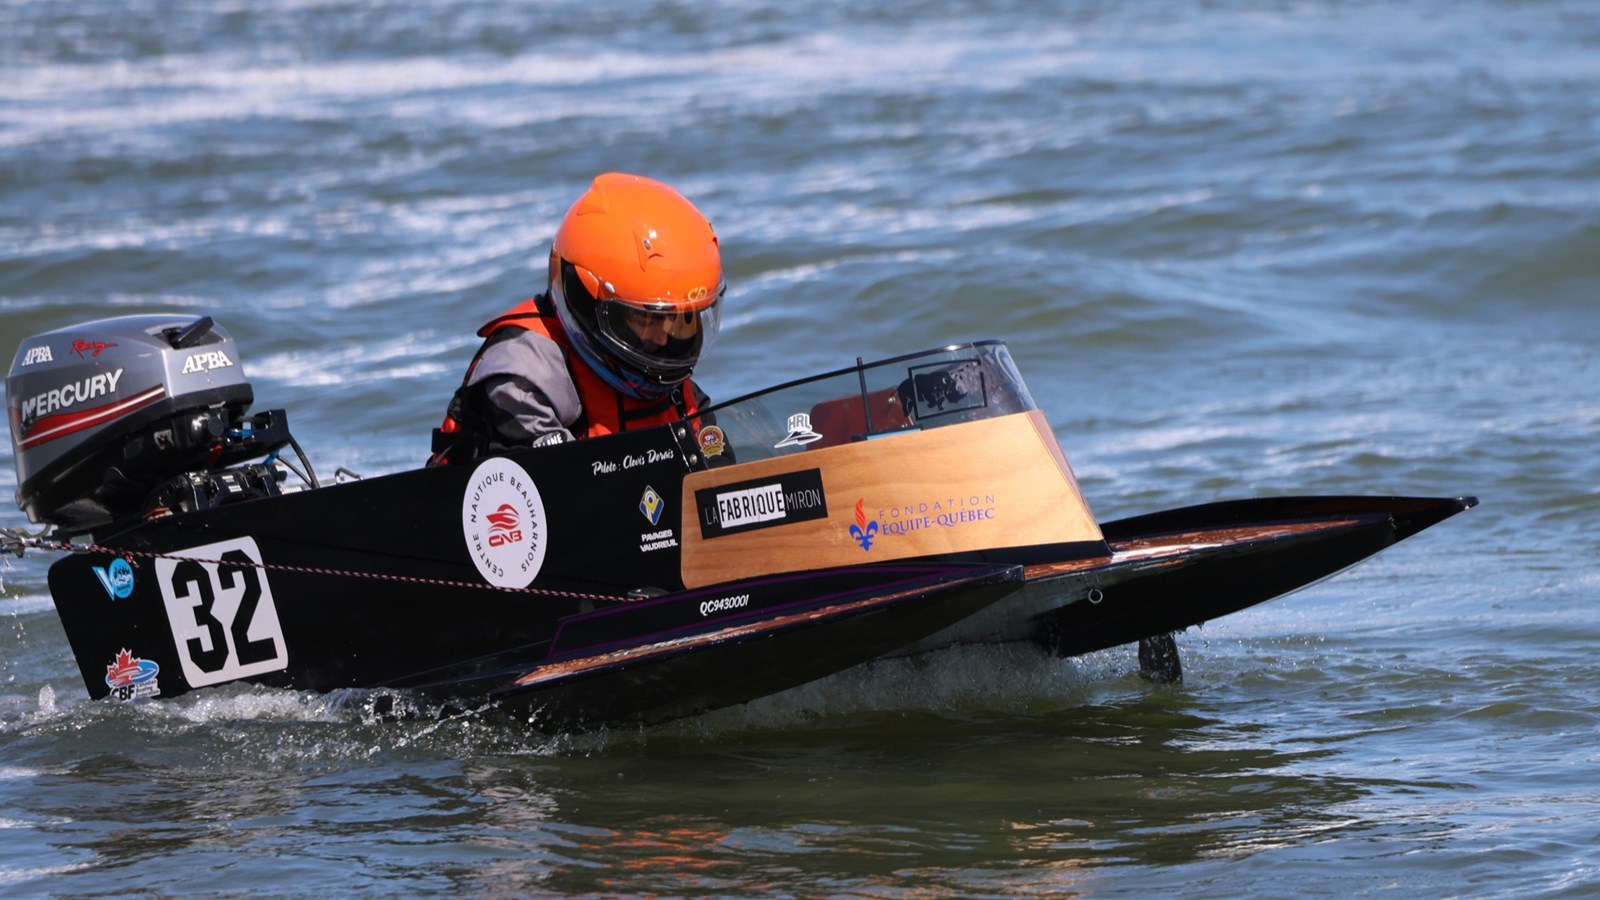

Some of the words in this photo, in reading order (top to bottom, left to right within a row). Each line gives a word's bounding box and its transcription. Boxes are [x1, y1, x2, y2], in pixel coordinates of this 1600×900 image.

[22, 346, 53, 366] APBA
[182, 350, 233, 374] APBA
[22, 368, 123, 422] MERCURY
[789, 415, 811, 431] HRL
[471, 472, 504, 523] NAUTIQUE
[879, 495, 995, 518] FONDATION
[510, 476, 538, 572] BEAUHARNOIS
[882, 508, 995, 535] ÉQUIPE-QUÉBEC
[640, 539, 679, 552] VAUDREUIL
[641, 529, 673, 542] PAVAGES
[473, 533, 504, 577] CENTRE
[171, 549, 278, 673] 32
[700, 594, 749, 616] QC9430001
